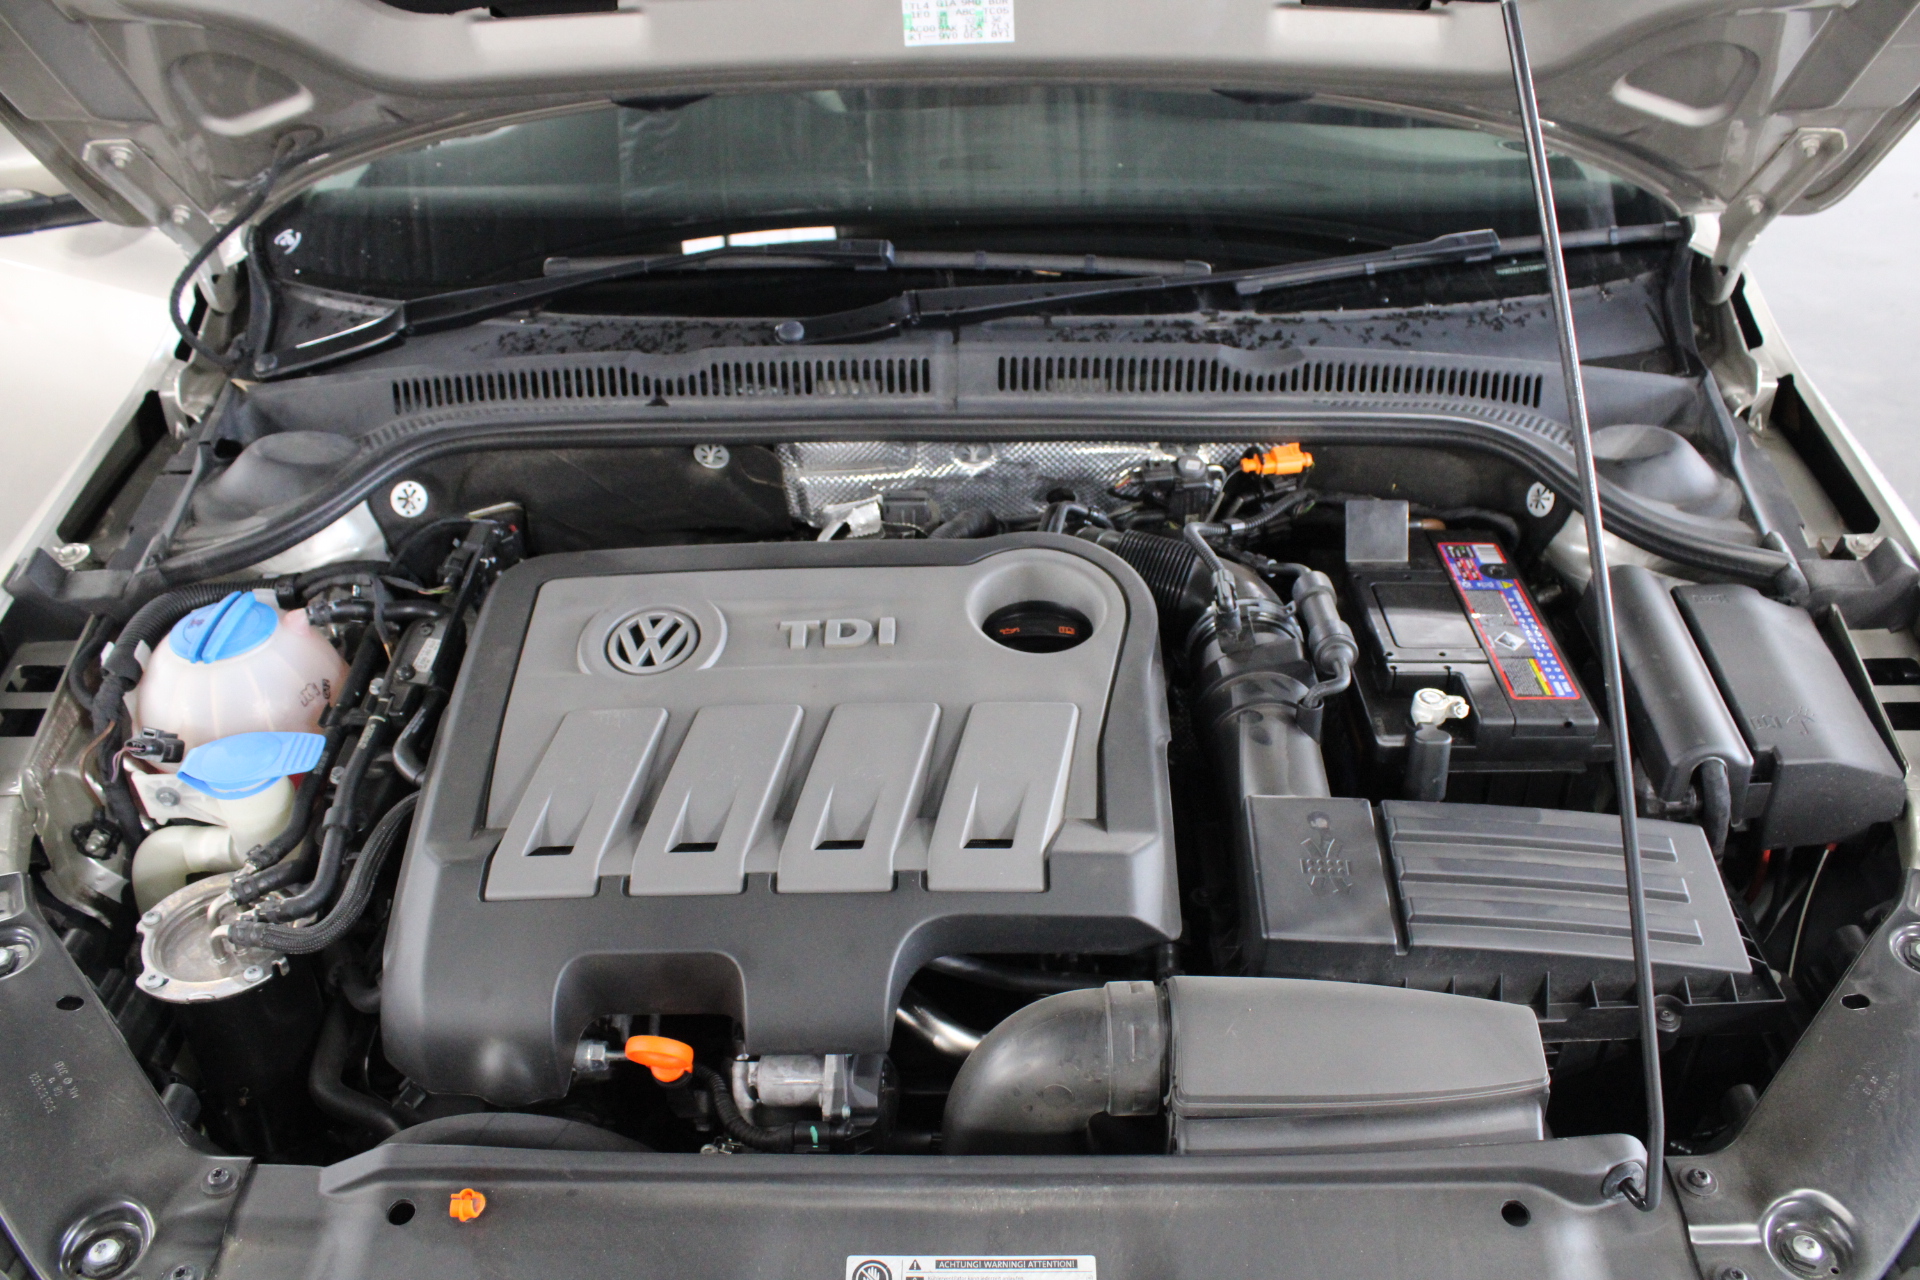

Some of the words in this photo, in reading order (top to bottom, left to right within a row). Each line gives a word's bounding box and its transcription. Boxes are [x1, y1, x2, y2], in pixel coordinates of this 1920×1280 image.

[779, 616, 897, 650] TDI
[938, 1260, 981, 1269] ACHTUNG!
[983, 1260, 1026, 1269] WARNING!
[1027, 1260, 1075, 1269] ATTENTION!
